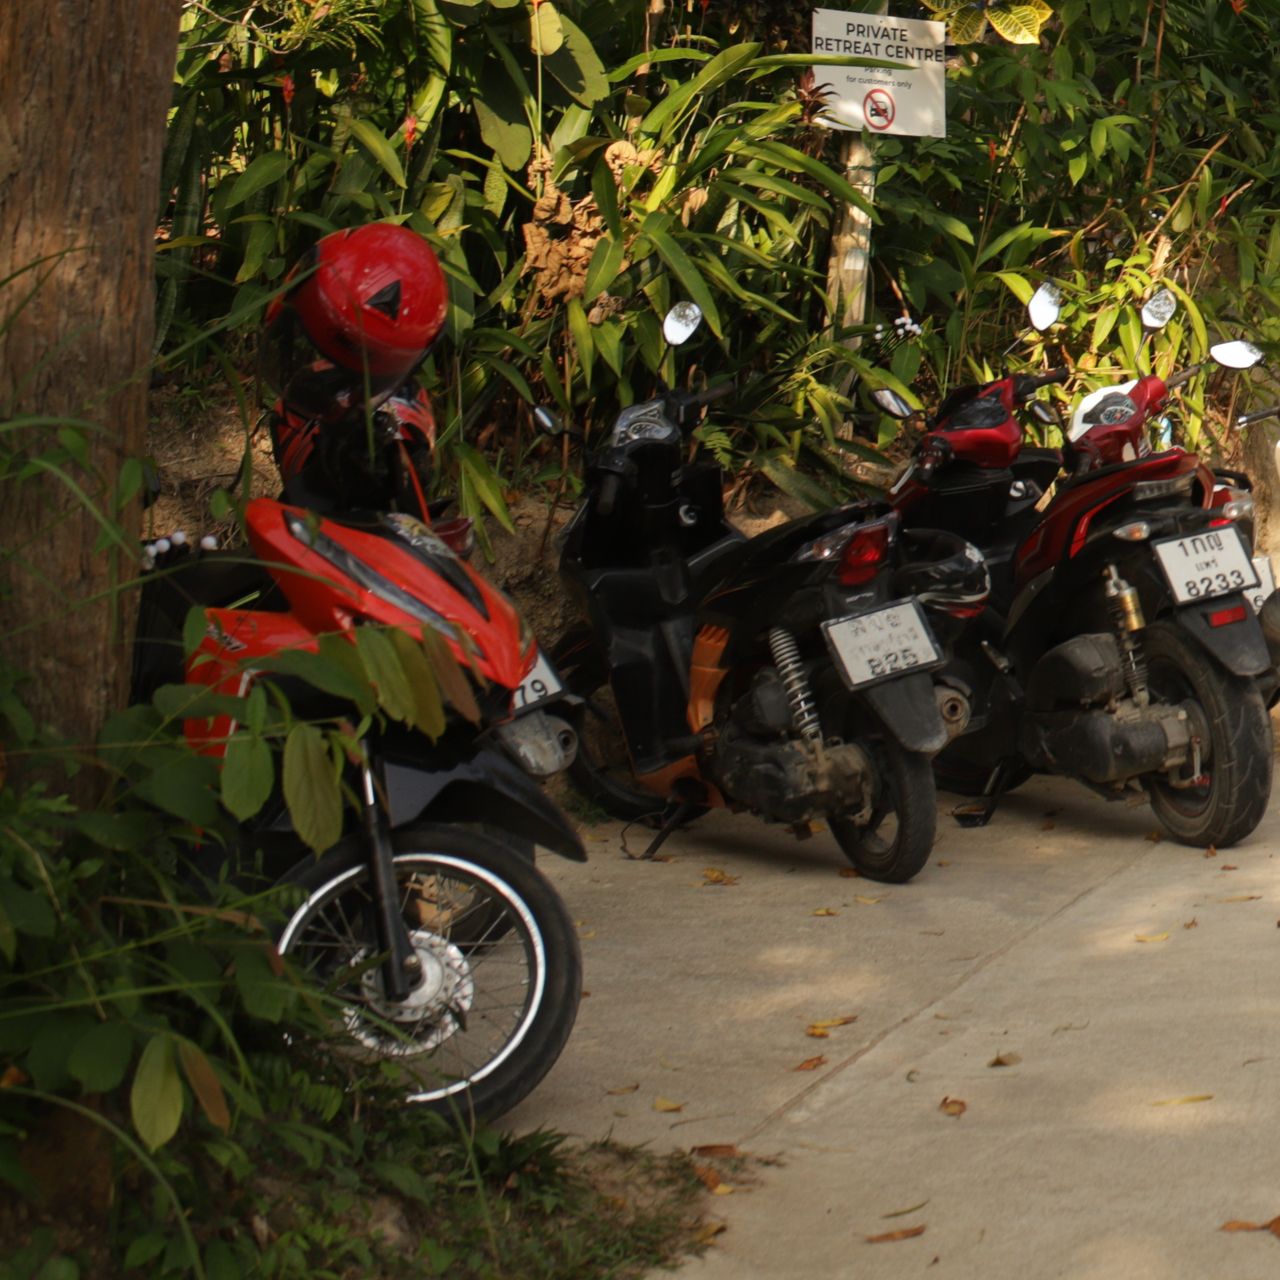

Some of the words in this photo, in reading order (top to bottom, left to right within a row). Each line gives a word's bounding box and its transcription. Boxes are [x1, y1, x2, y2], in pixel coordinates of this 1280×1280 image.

[846, 22, 908, 42] PRIVATE
[814, 36, 881, 56] RETREAT
[885, 44, 944, 63] CENTRE
[857, 77, 896, 87] customers
[897, 81, 912, 90] only
[1185, 569, 1246, 597] 8233
